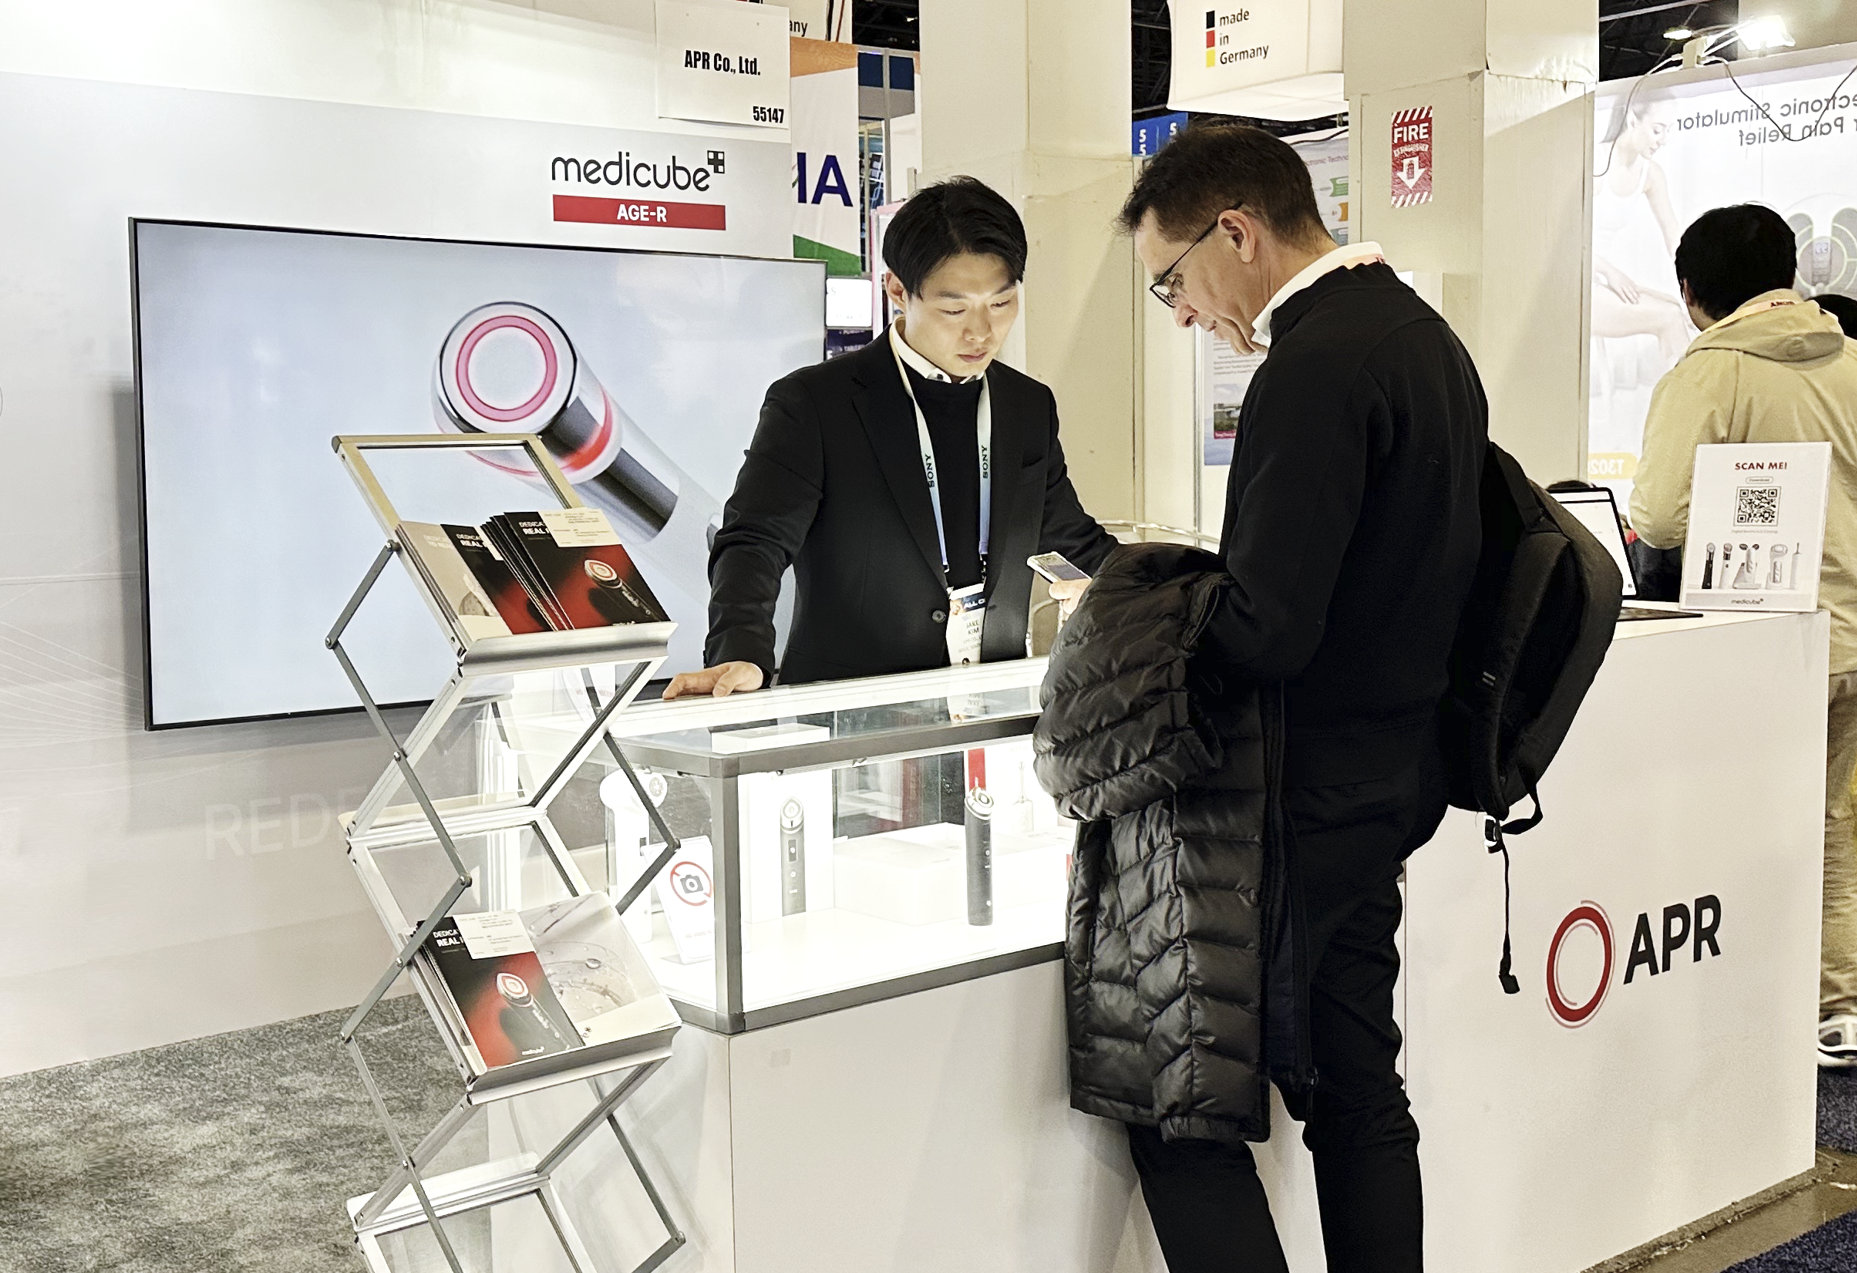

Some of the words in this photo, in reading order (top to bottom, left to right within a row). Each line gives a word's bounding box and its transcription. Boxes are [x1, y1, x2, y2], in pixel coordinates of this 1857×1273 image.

[1219, 9, 1250, 27] made
[789, 20, 808, 37] any
[1219, 33, 1230, 46] in
[684, 50, 711, 70] APR
[713, 53, 737, 75] Co.,
[738, 56, 761, 76] Ltd.
[1219, 45, 1270, 65] Germany
[752, 105, 785, 124] 55147
[1393, 122, 1429, 144] FIRE
[551, 151, 711, 192] medicube
[796, 151, 854, 208] IA
[616, 203, 667, 223] AGE-R
[924, 453, 935, 488] SONY
[981, 444, 989, 479] SONY
[1734, 462, 1765, 471] SCAN
[522, 527, 546, 535] REAL
[963, 600, 979, 609] ALL
[433, 929, 459, 938] DEDICA
[436, 937, 460, 948] REAL
[1623, 894, 1722, 985] APR
